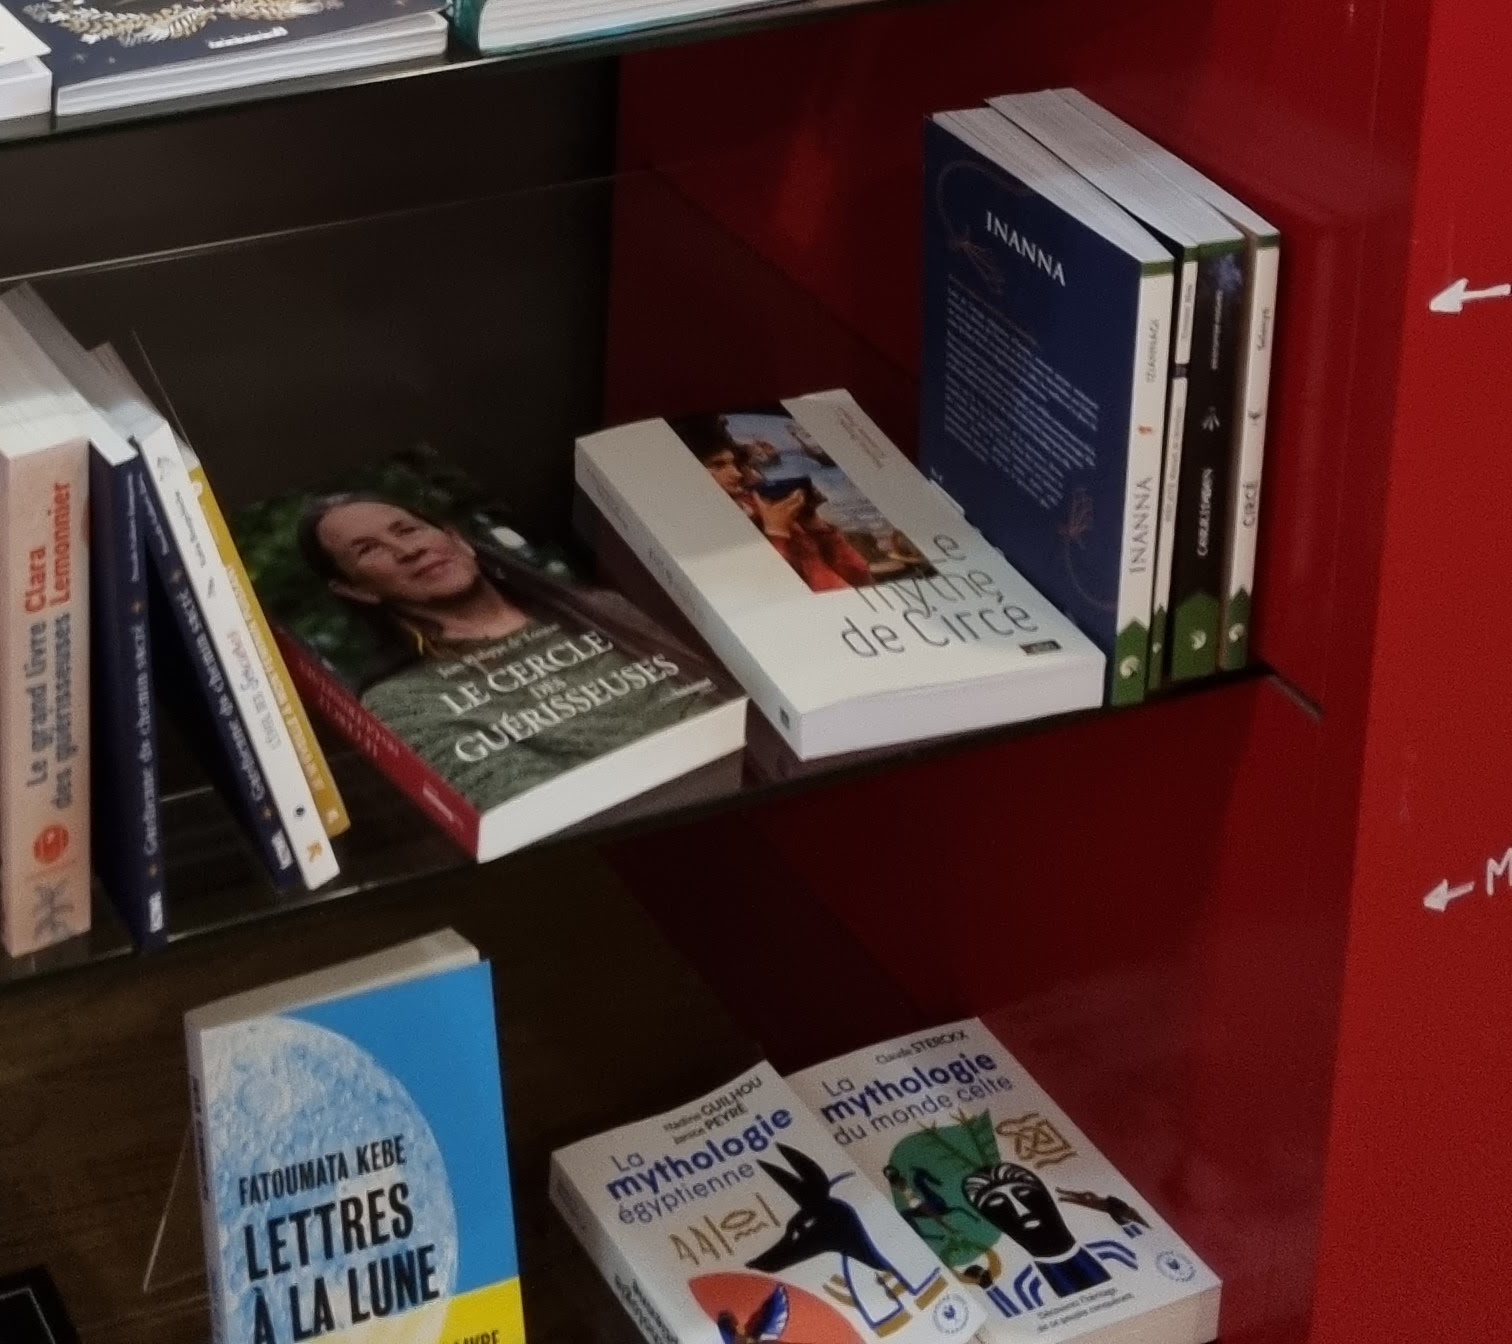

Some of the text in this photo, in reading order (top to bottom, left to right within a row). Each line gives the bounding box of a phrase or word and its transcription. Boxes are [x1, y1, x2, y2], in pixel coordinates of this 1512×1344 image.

[986, 211, 1066, 287] INANNA
[47, 481, 73, 604] Lemonnier
[1129, 474, 1154, 575] INANNA
[23, 544, 48, 613] Clara
[130, 622, 149, 671] sacré
[841, 589, 1038, 657] de Circé
[194, 632, 227, 693] chemin
[440, 682, 491, 716] LE
[488, 630, 614, 692] CERCLE
[23, 620, 57, 785] Le grand livre
[49, 612, 78, 809] des guérisseuses
[135, 673, 152, 736] chemin
[455, 653, 680, 762] GUÉRISSEUSES
[700, 1076, 763, 1116] GUILHOU
[820, 1052, 997, 1124] mythologie
[821, 1078, 855, 1097] La
[834, 1075, 1013, 1146] du monde celte
[238, 1133, 408, 1206] FATOUMATA KEBE
[606, 1109, 793, 1201] mythologie
[611, 1152, 646, 1172] La
[618, 1163, 755, 1224] égyptienne
[243, 1182, 415, 1282] LETTRES
[252, 1244, 442, 1344] À LA LUNE
